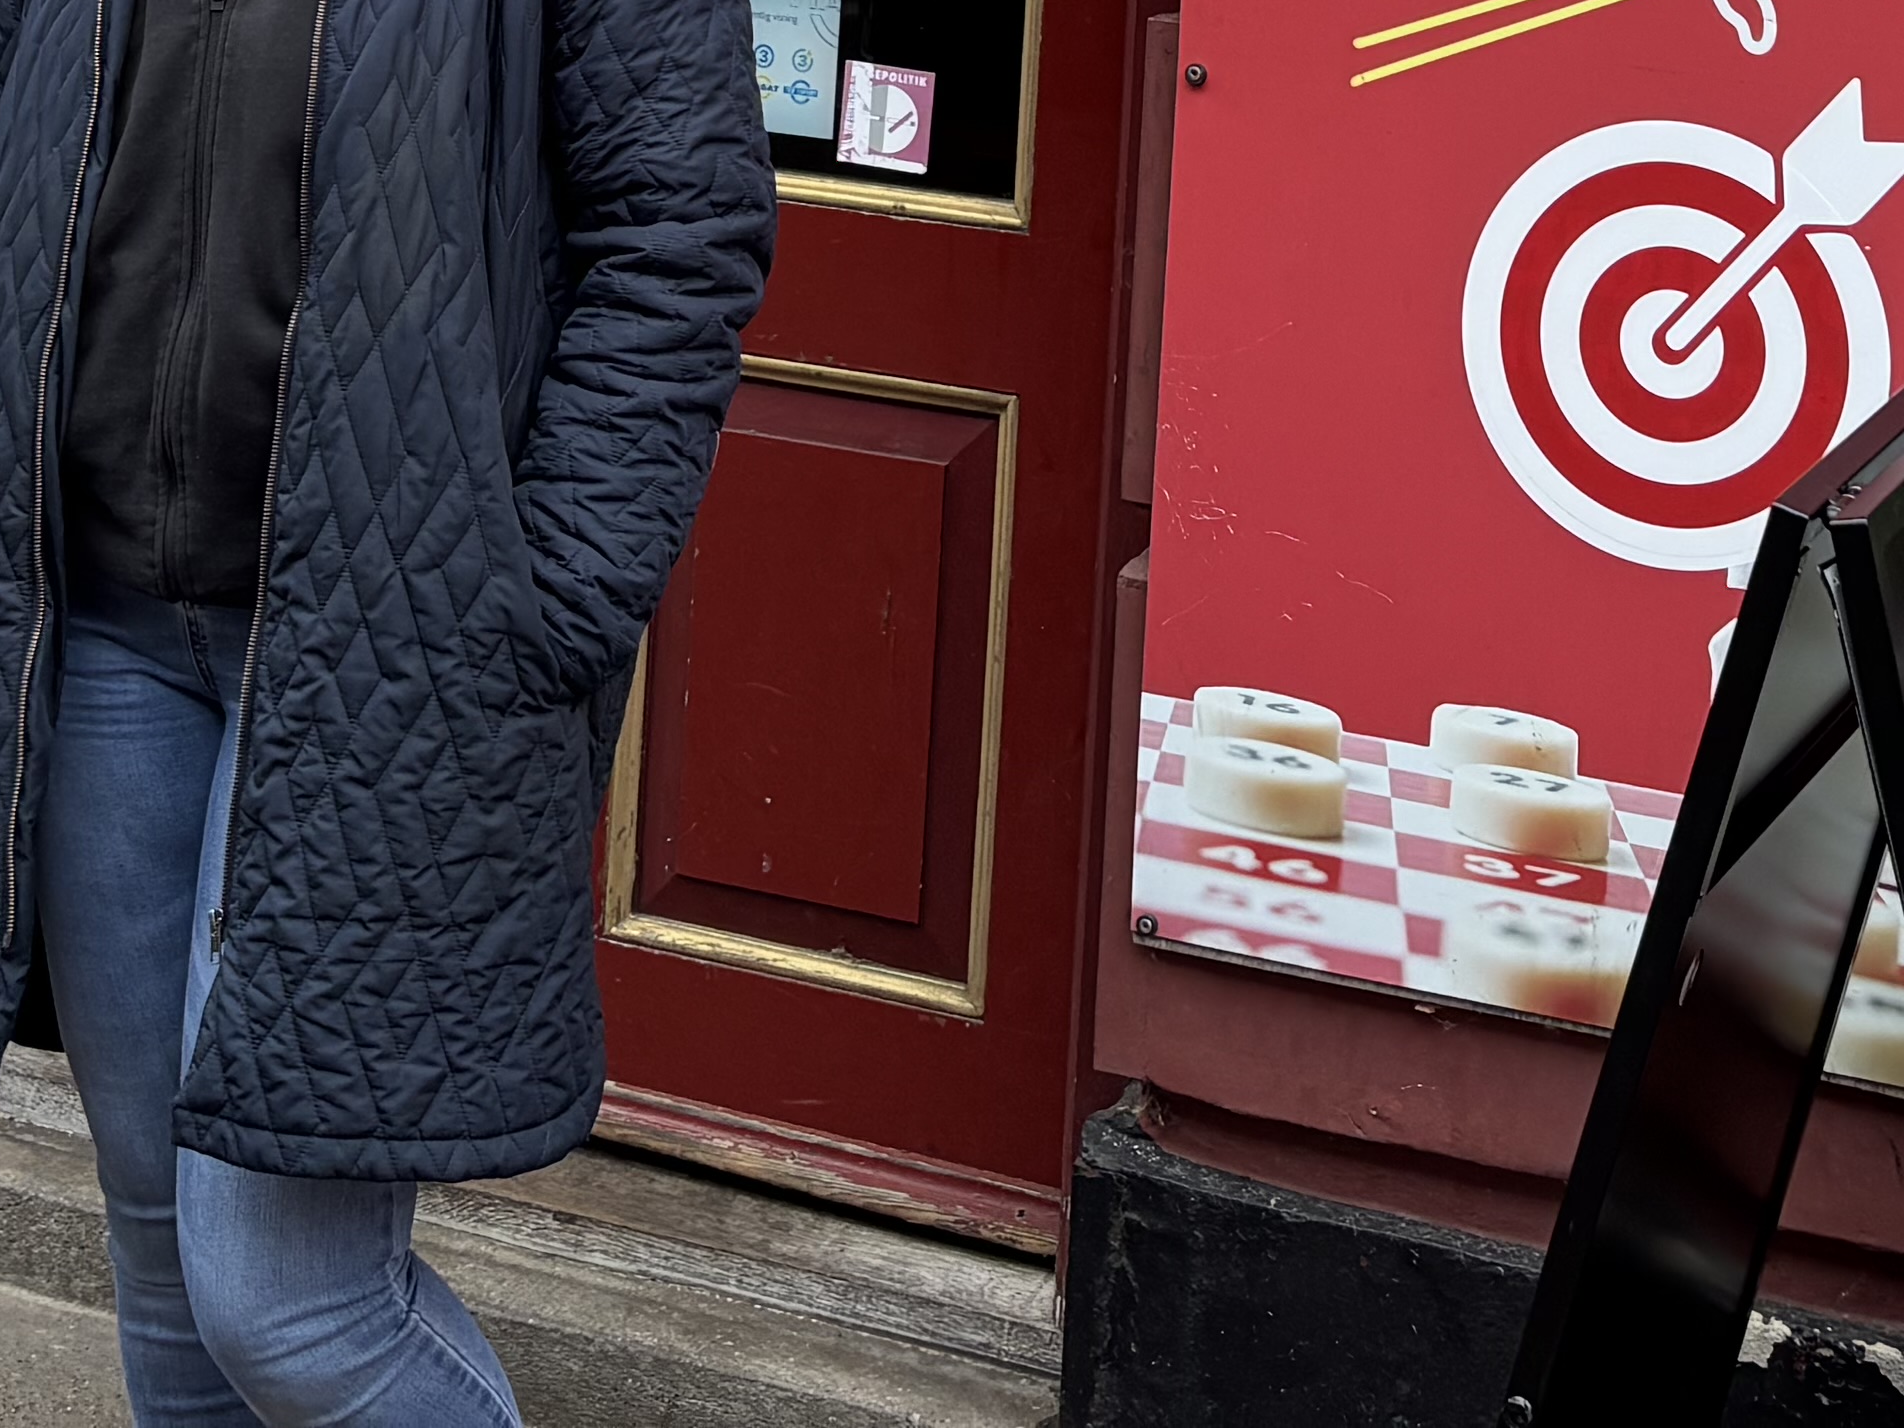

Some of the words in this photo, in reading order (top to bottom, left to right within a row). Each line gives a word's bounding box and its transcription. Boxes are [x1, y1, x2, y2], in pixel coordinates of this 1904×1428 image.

[875, 69, 927, 87] EPOLITIK
[1237, 693, 1301, 715] 16
[1489, 770, 1571, 793] 27
[1199, 844, 1329, 886] 46
[1463, 853, 1583, 888] 37
